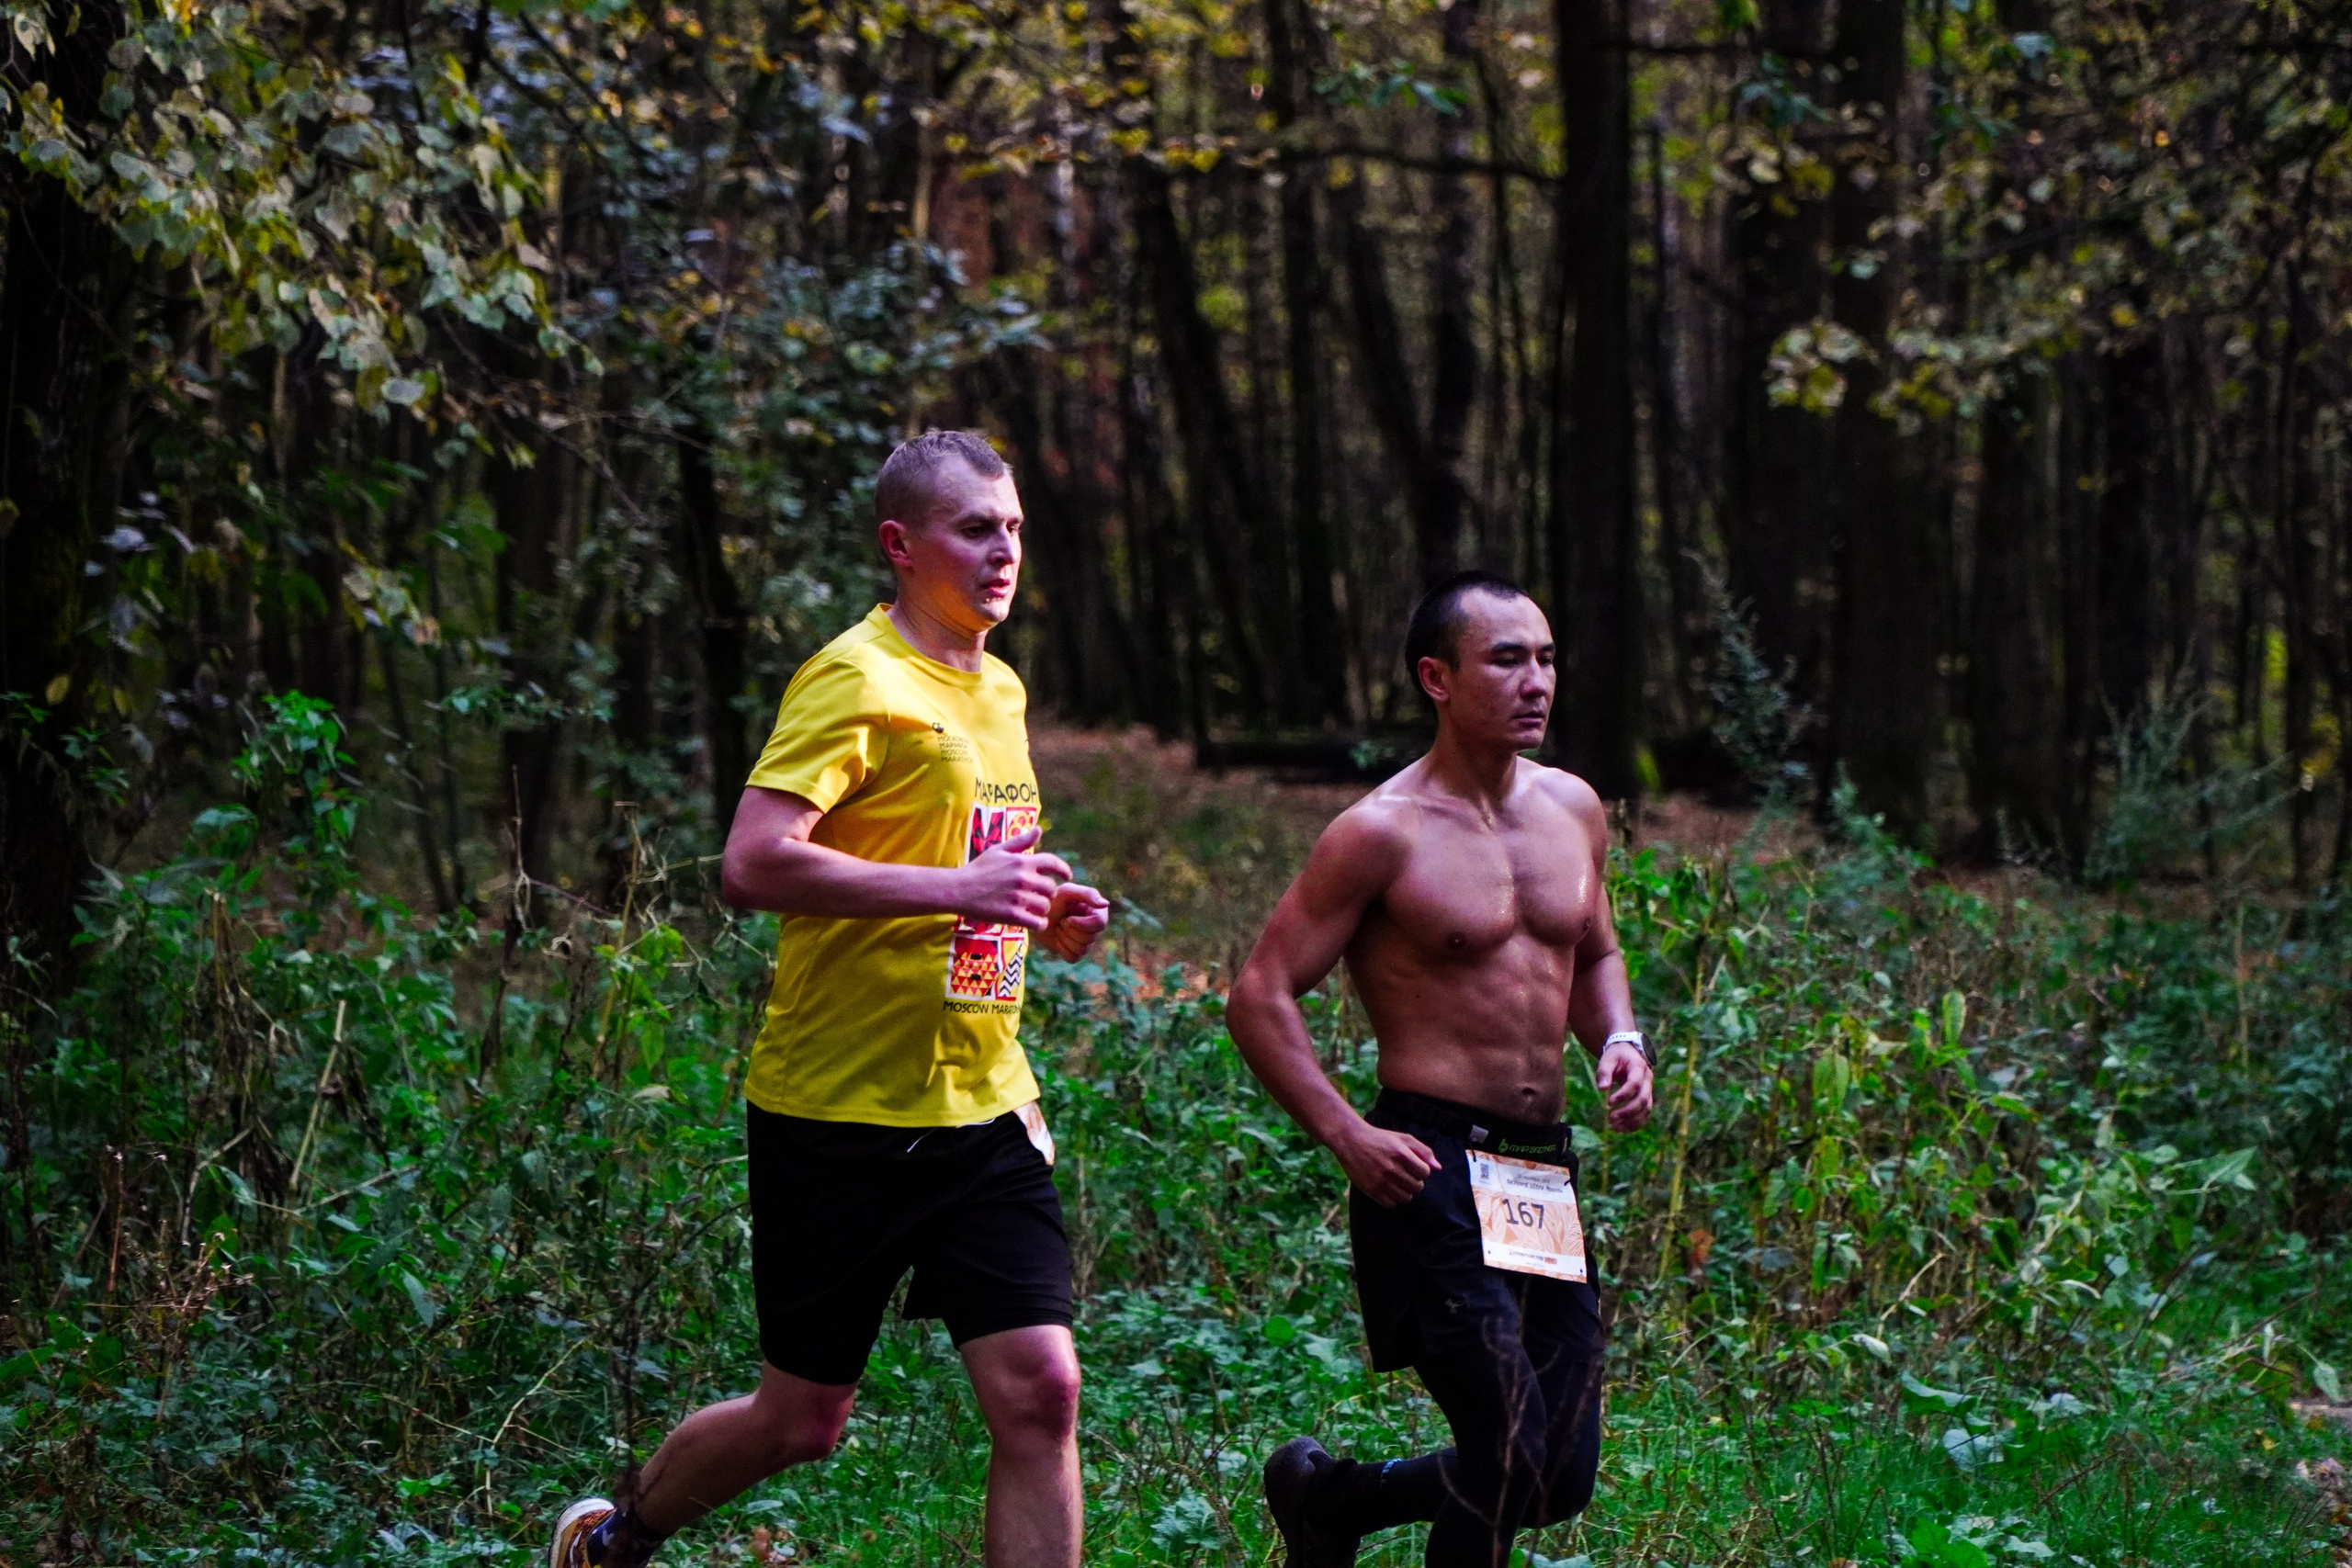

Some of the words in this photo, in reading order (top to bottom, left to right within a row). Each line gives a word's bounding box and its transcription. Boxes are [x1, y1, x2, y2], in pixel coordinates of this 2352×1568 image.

[974, 777, 1037, 804] МАРАФОН
[943, 1000, 989, 1014] MOSCOW
[1502, 1198, 1544, 1229] 167
